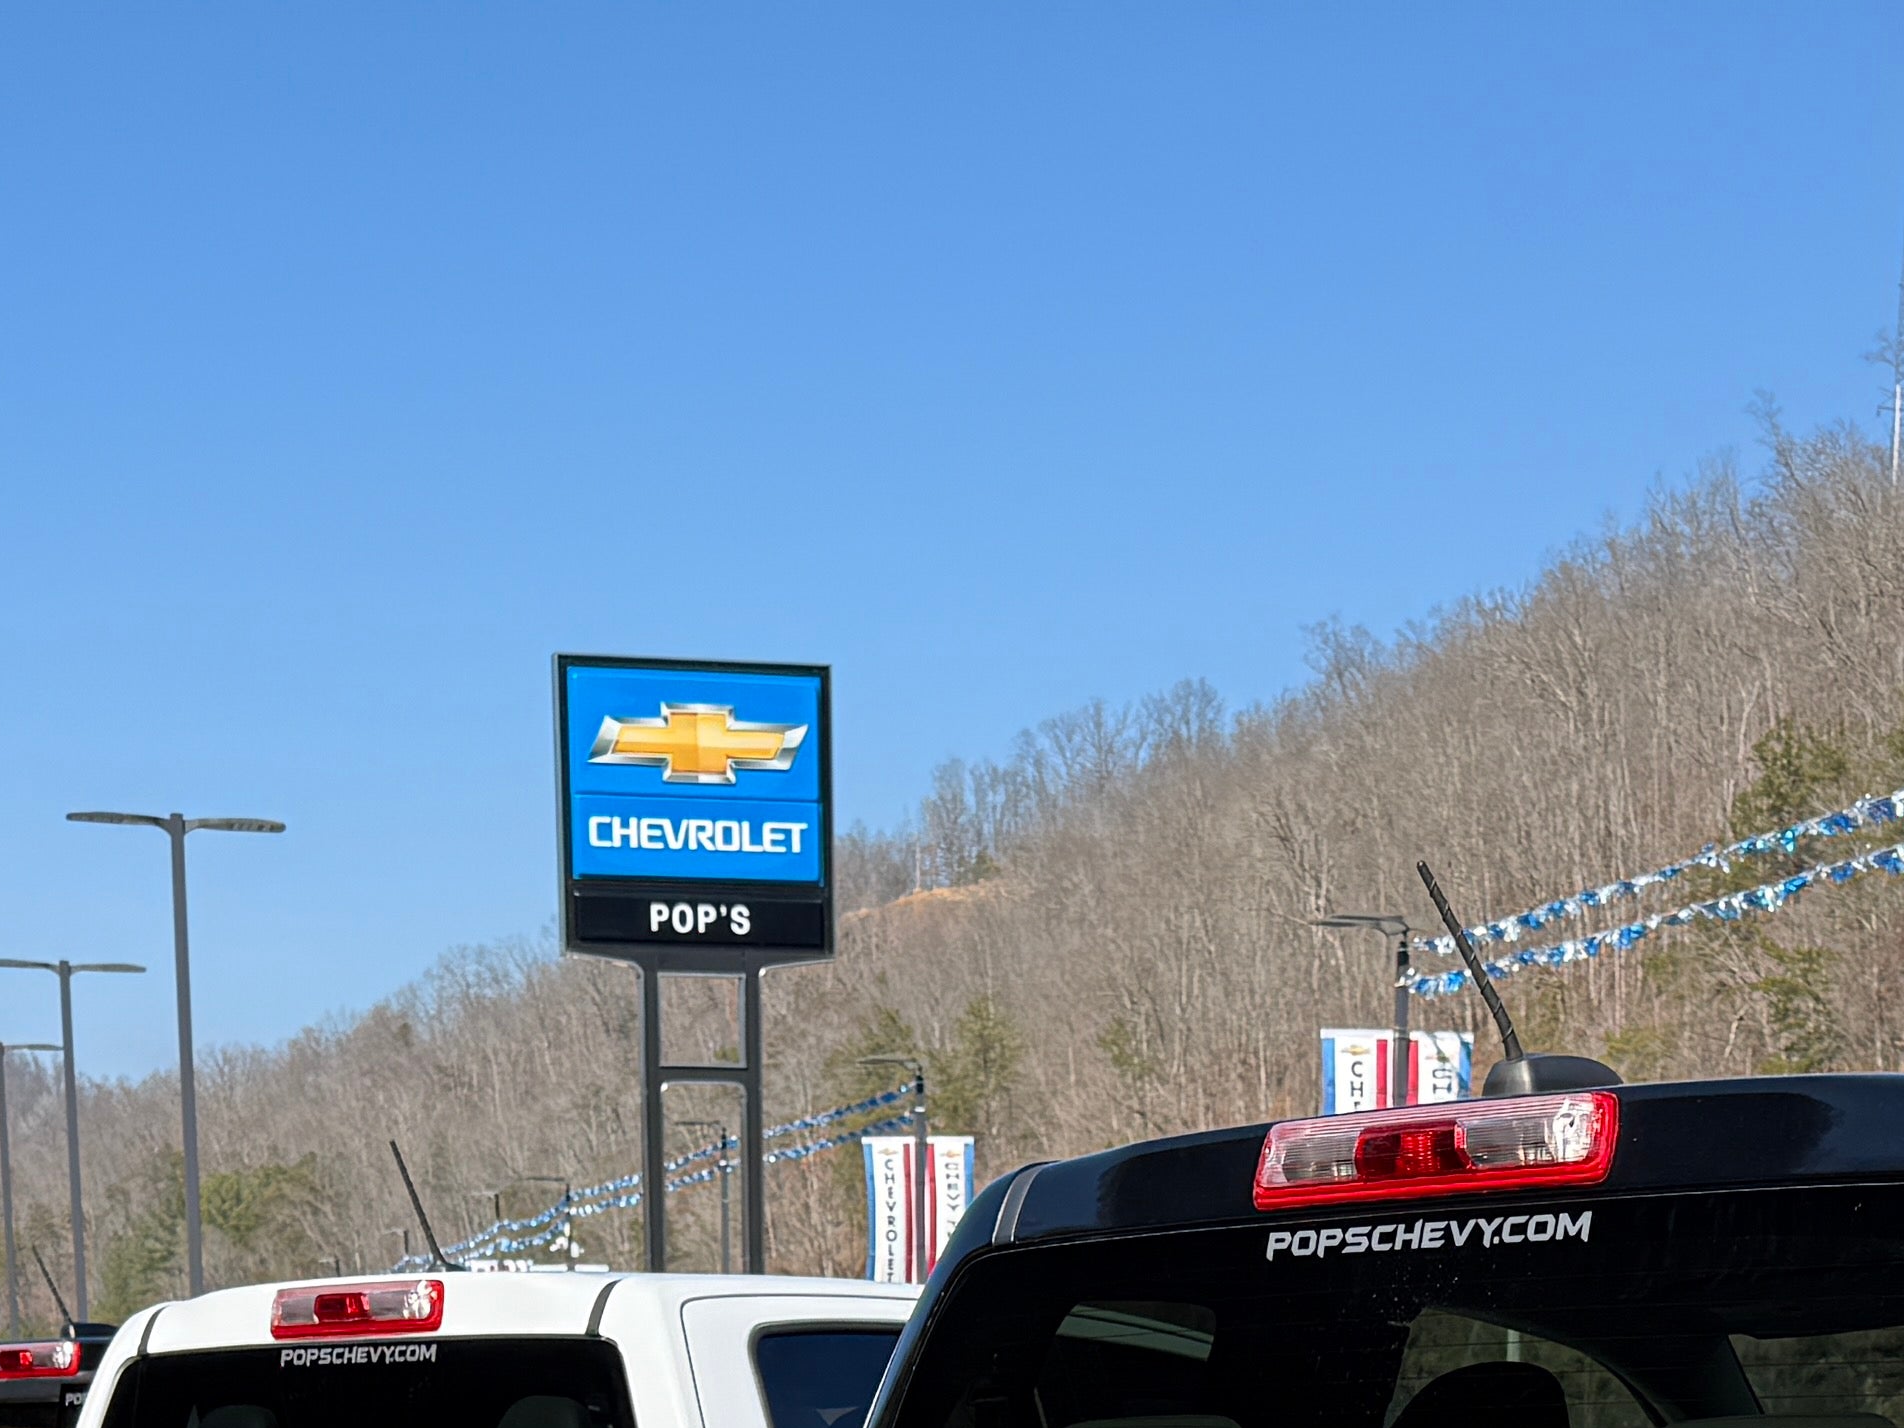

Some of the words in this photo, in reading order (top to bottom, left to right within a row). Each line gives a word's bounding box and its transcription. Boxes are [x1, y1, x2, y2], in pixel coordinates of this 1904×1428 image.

[588, 816, 808, 853] CHEVROLET
[649, 902, 751, 936] POP'S
[884, 1158, 898, 1283] CHEVROLET
[1266, 1210, 1593, 1262] POPSCHEVY.COM
[280, 1344, 438, 1368] POPSCHEVY.COM
